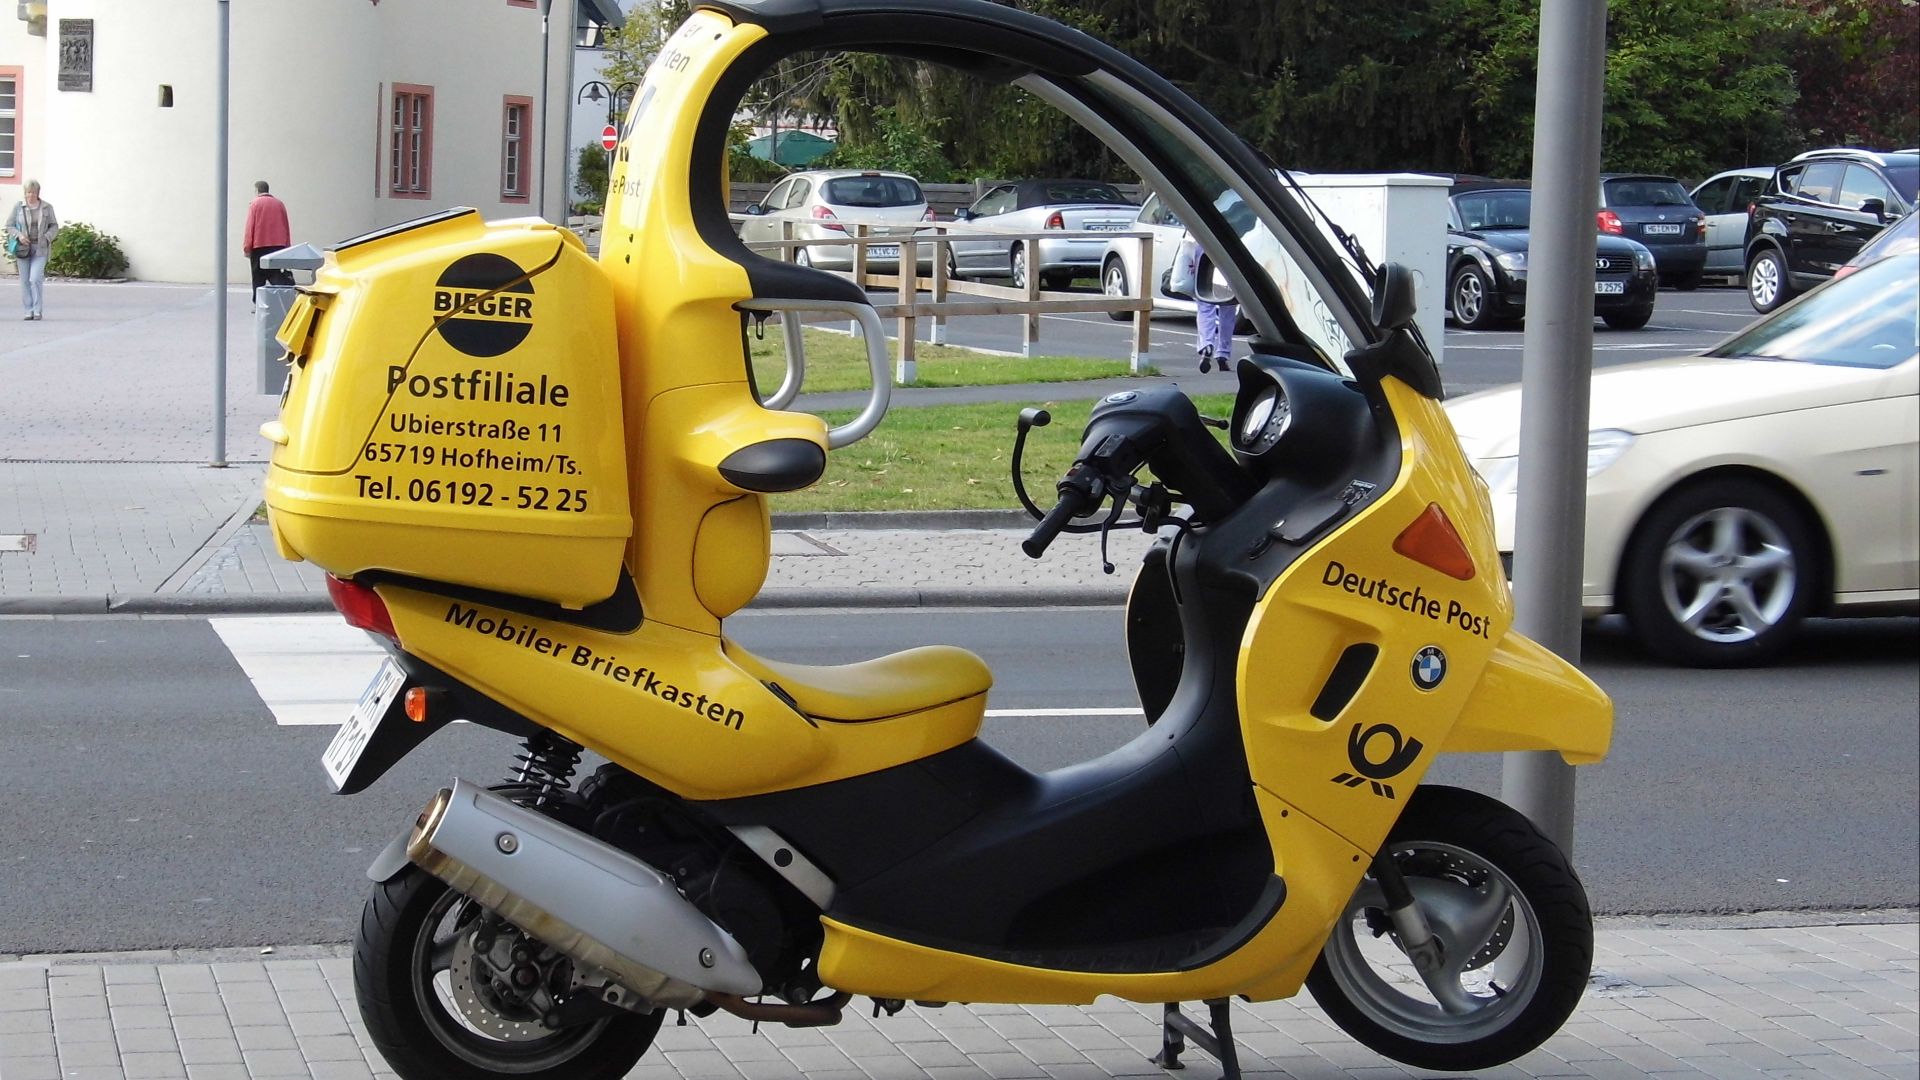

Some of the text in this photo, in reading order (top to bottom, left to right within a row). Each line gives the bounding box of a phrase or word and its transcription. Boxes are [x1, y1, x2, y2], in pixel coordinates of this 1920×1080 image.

[434, 291, 532, 319] BIEGER
[387, 365, 569, 407] Postfiliale
[390, 413, 561, 442] Ubierstraße 11
[364, 442, 583, 475] 65719 Hofheim/Ts.
[354, 475, 401, 500] Tel.
[408, 478, 493, 507] 06192
[1322, 560, 1491, 640] Deutsche Post
[444, 603, 745, 731] Mobiler Briefkasten
